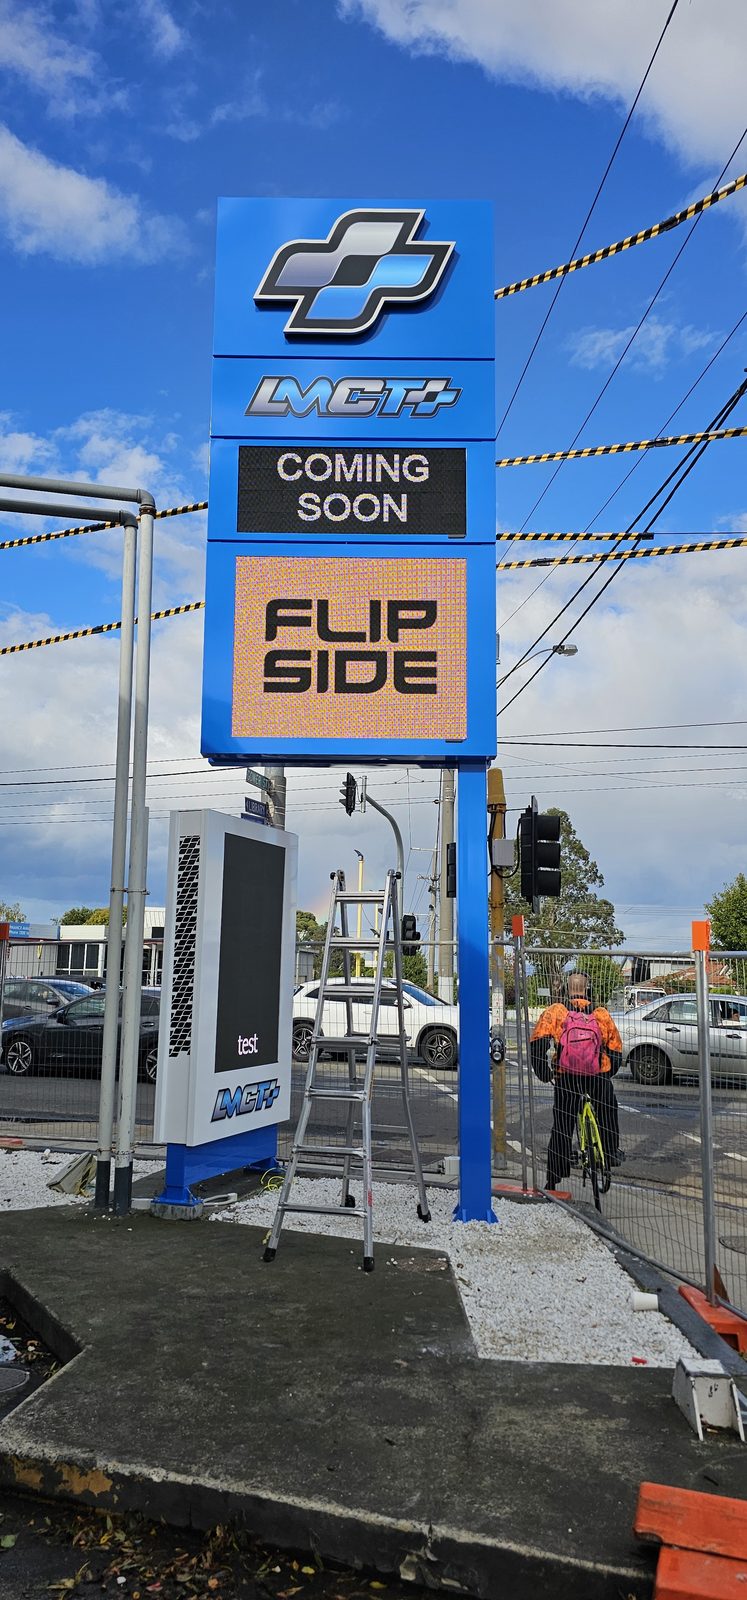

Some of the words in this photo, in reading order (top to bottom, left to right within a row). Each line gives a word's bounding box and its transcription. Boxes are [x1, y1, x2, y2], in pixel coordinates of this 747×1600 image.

[277, 453, 430, 482] COMING
[297, 493, 408, 523] SOON
[265, 599, 437, 643] FLIP
[263, 650, 437, 694] SIDE
[238, 1033, 258, 1055] test
